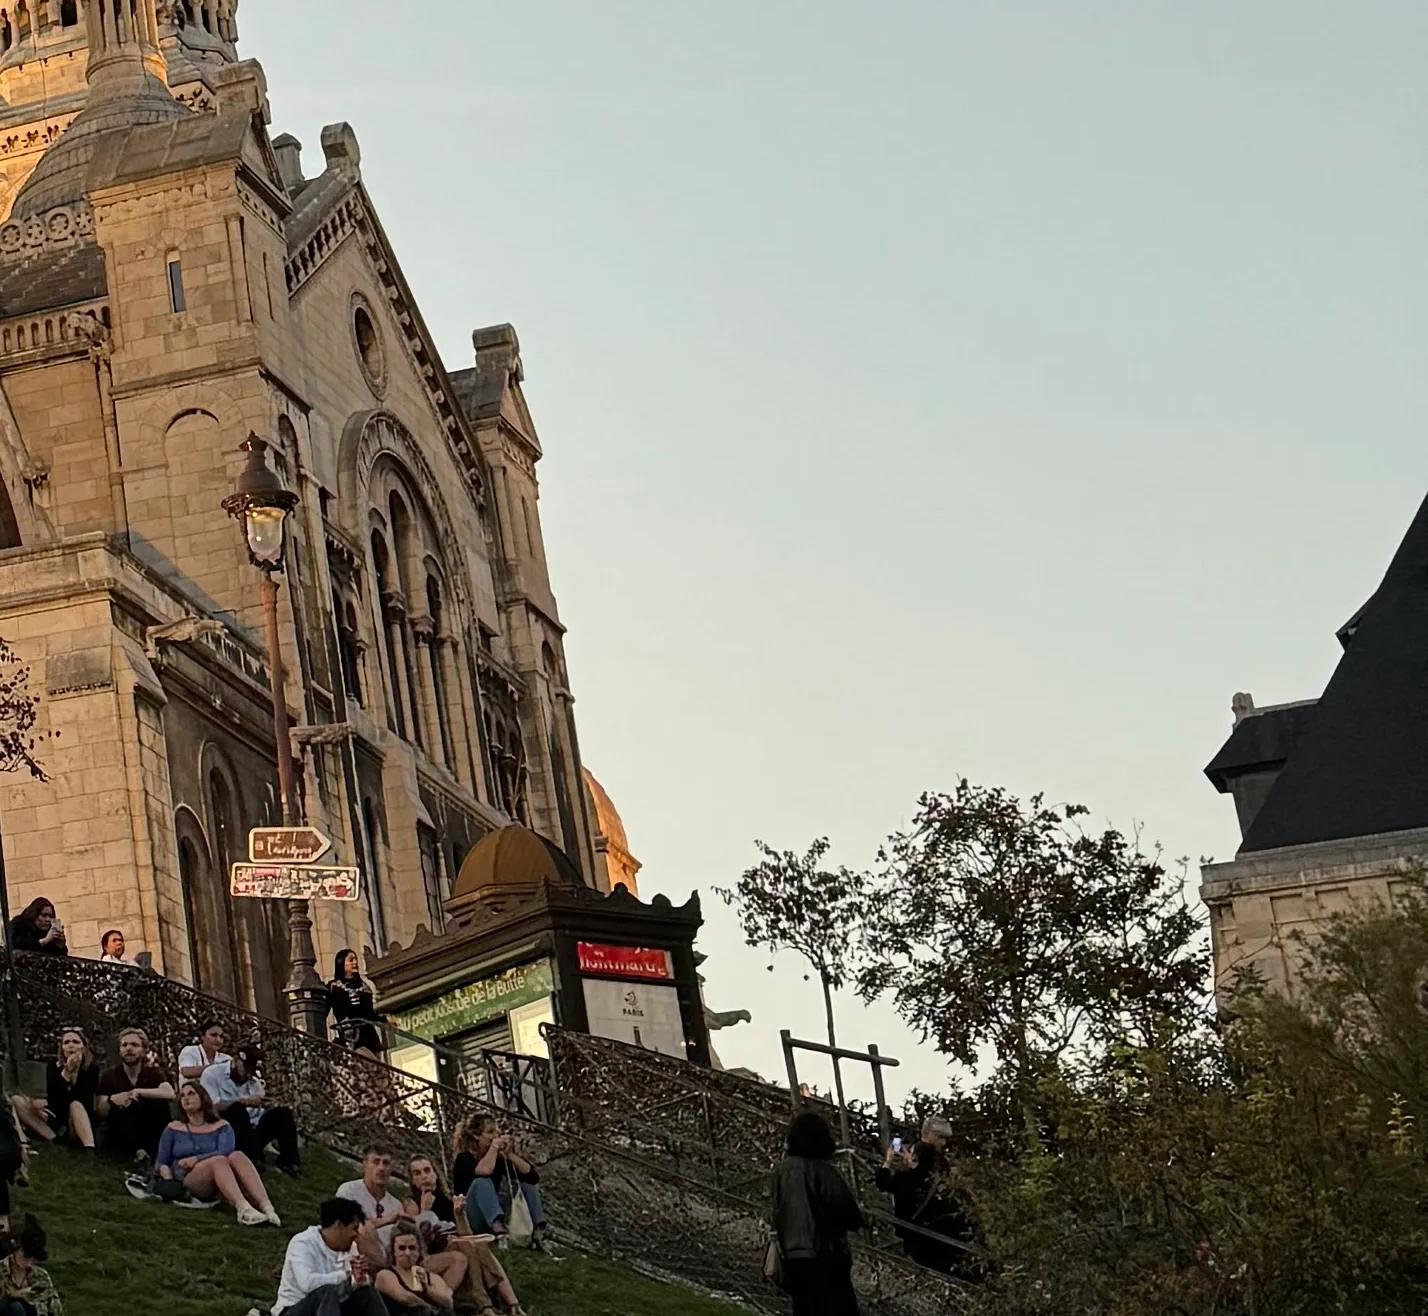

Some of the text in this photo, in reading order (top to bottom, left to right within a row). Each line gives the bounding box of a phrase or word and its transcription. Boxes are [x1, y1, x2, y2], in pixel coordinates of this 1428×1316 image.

[472, 985, 486, 1005] de
[486, 980, 496, 1000] la
[496, 976, 525, 996] Butte
[622, 1008, 644, 1017] PARIS
